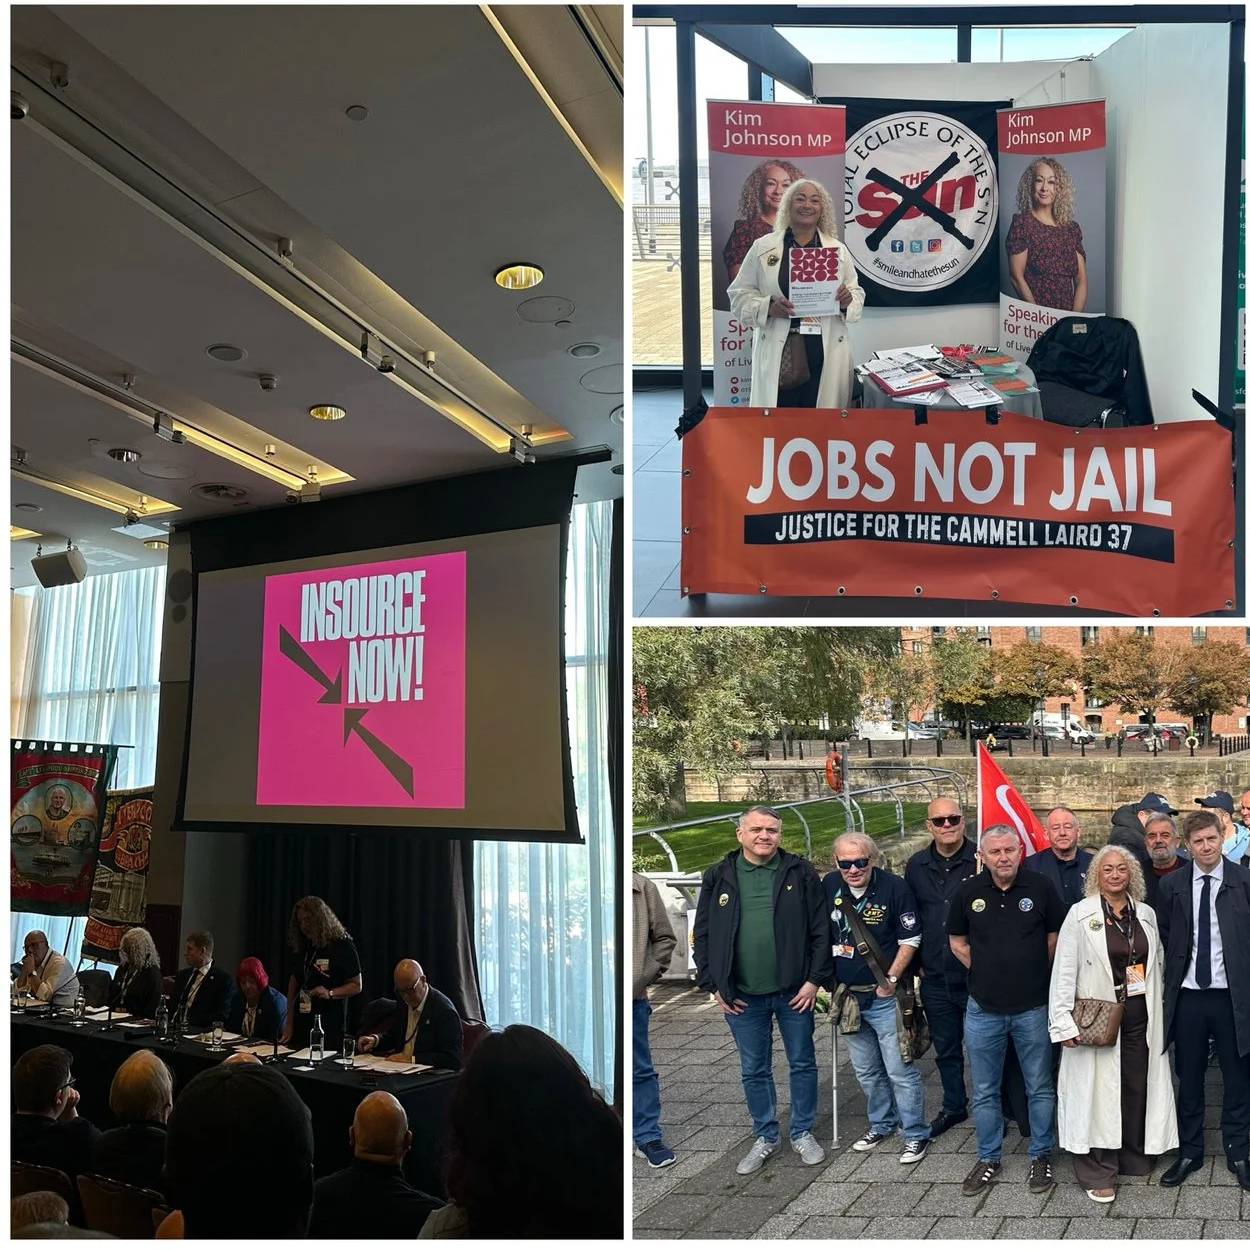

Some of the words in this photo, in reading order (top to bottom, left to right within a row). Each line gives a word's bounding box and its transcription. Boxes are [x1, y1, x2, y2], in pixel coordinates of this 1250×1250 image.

[725, 110, 762, 126] Kim
[1008, 114, 1034, 128] Kim
[723, 129, 802, 148] Johnson
[808, 134, 832, 146] MP
[1006, 130, 1064, 148] Johnson
[1069, 128, 1091, 142] MP
[854, 121, 929, 160] ECLIPSE
[937, 128, 965, 148] OF
[963, 144, 988, 183] THE
[900, 170, 930, 185] THE
[873, 257, 959, 278] #smileandhatethesun
[1004, 320, 1025, 335] for
[720, 337, 747, 351] for
[1006, 340, 1014, 348] of
[725, 358, 736, 367] of
[746, 437, 896, 504] JOBS
[914, 440, 1036, 506] NOT
[1048, 447, 1172, 516] JAIL
[775, 512, 857, 542] JUSTICE
[862, 512, 898, 538] FOR
[904, 513, 941, 541] THE
[946, 516, 1038, 546] CAMMELL
[1044, 522, 1100, 546] LAIRD
[1107, 524, 1132, 550] 37
[300, 570, 426, 643] INSOURCE
[348, 636, 424, 704] NOW!
